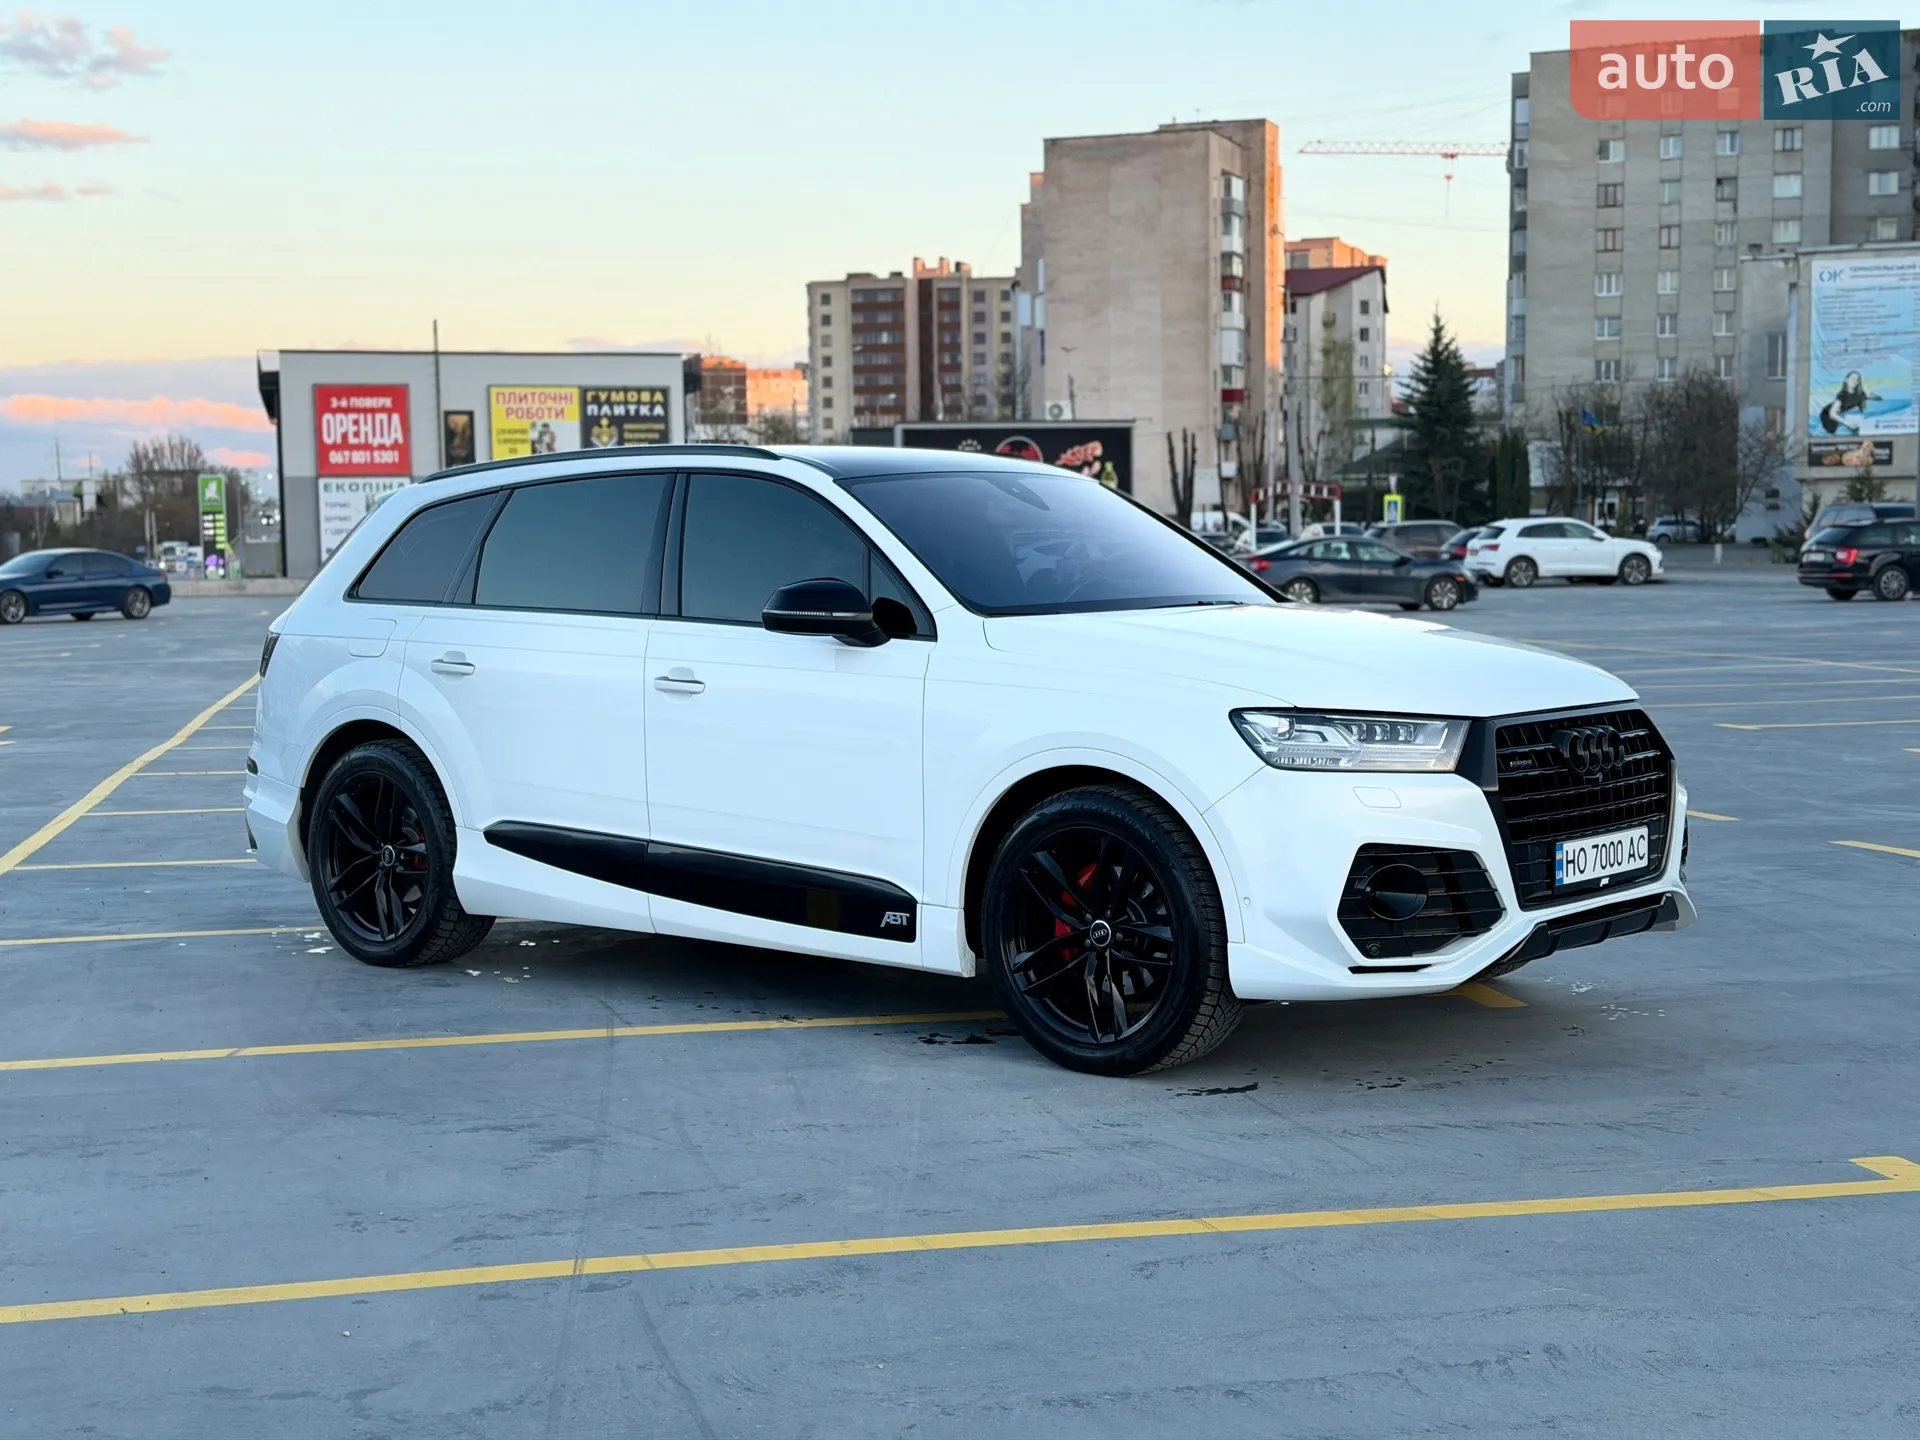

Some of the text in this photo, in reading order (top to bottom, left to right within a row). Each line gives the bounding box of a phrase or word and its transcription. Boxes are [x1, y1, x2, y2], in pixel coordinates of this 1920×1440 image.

[349, 396, 393, 409] ПОВЕРХ
[495, 391, 573, 405] ПЛИТОЧНІ
[586, 391, 664, 403] ГУМОВА
[505, 407, 565, 420] РОБОТИ
[586, 404, 665, 417] ПЛИТКА
[321, 412, 404, 448] ОРЕНДА
[1565, 834, 1646, 878] HO 7000 AC
[880, 911, 910, 928] ABT
